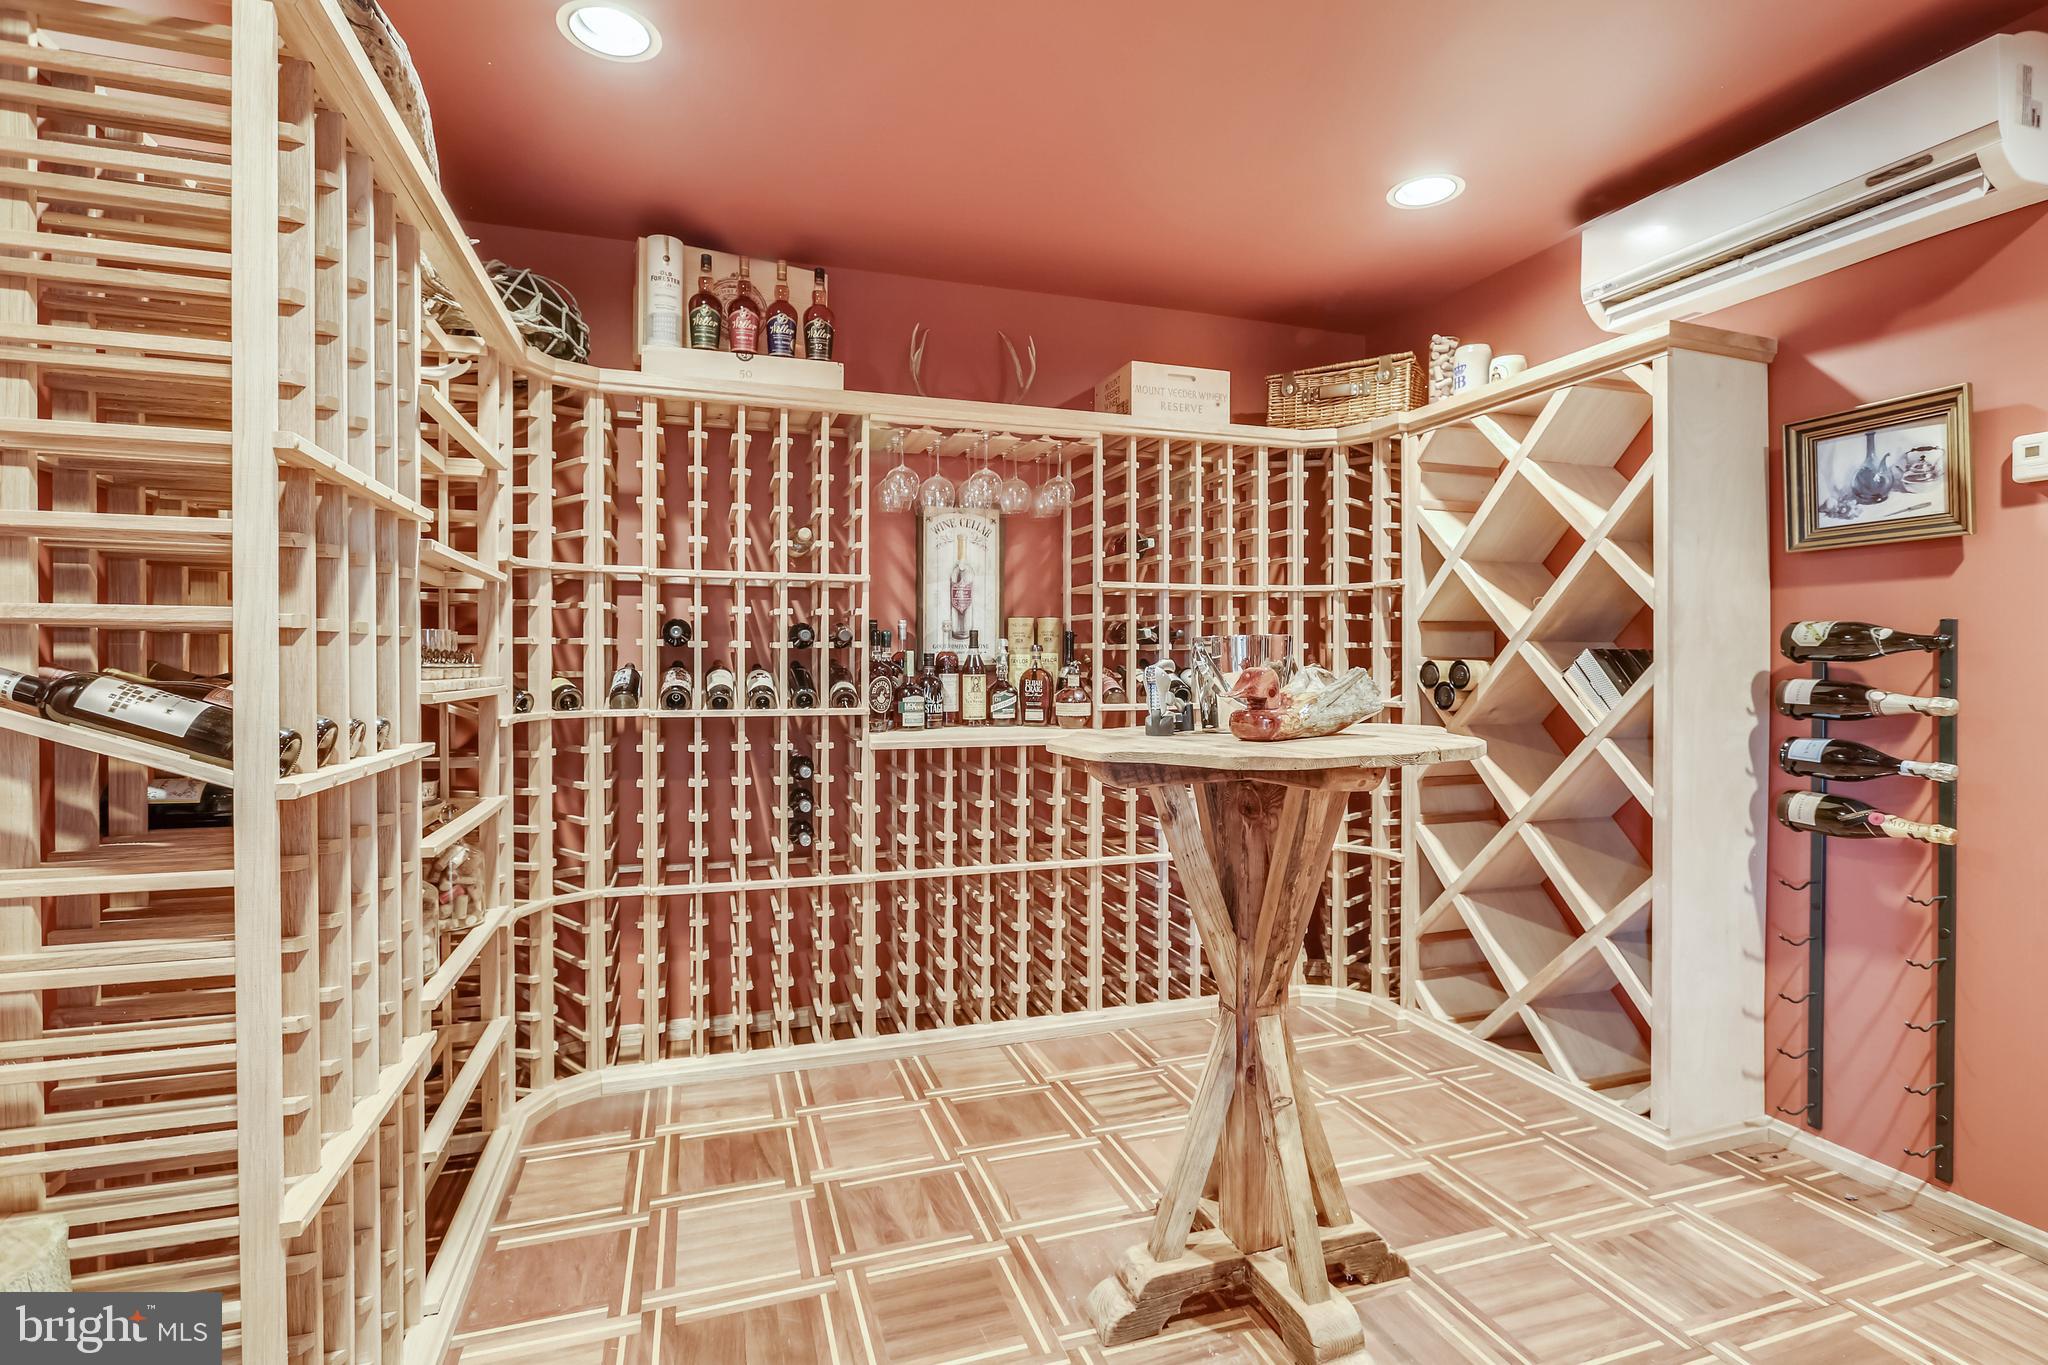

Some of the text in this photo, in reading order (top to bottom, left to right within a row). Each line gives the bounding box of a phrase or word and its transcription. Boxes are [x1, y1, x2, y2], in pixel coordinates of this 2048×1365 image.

[650, 275, 680, 285] FORESTER
[1135, 384, 1228, 402] MOUNT VEEDER WINERY
[1160, 401, 1203, 414] RESERVE
[931, 517, 993, 538] WINE CELLAR
